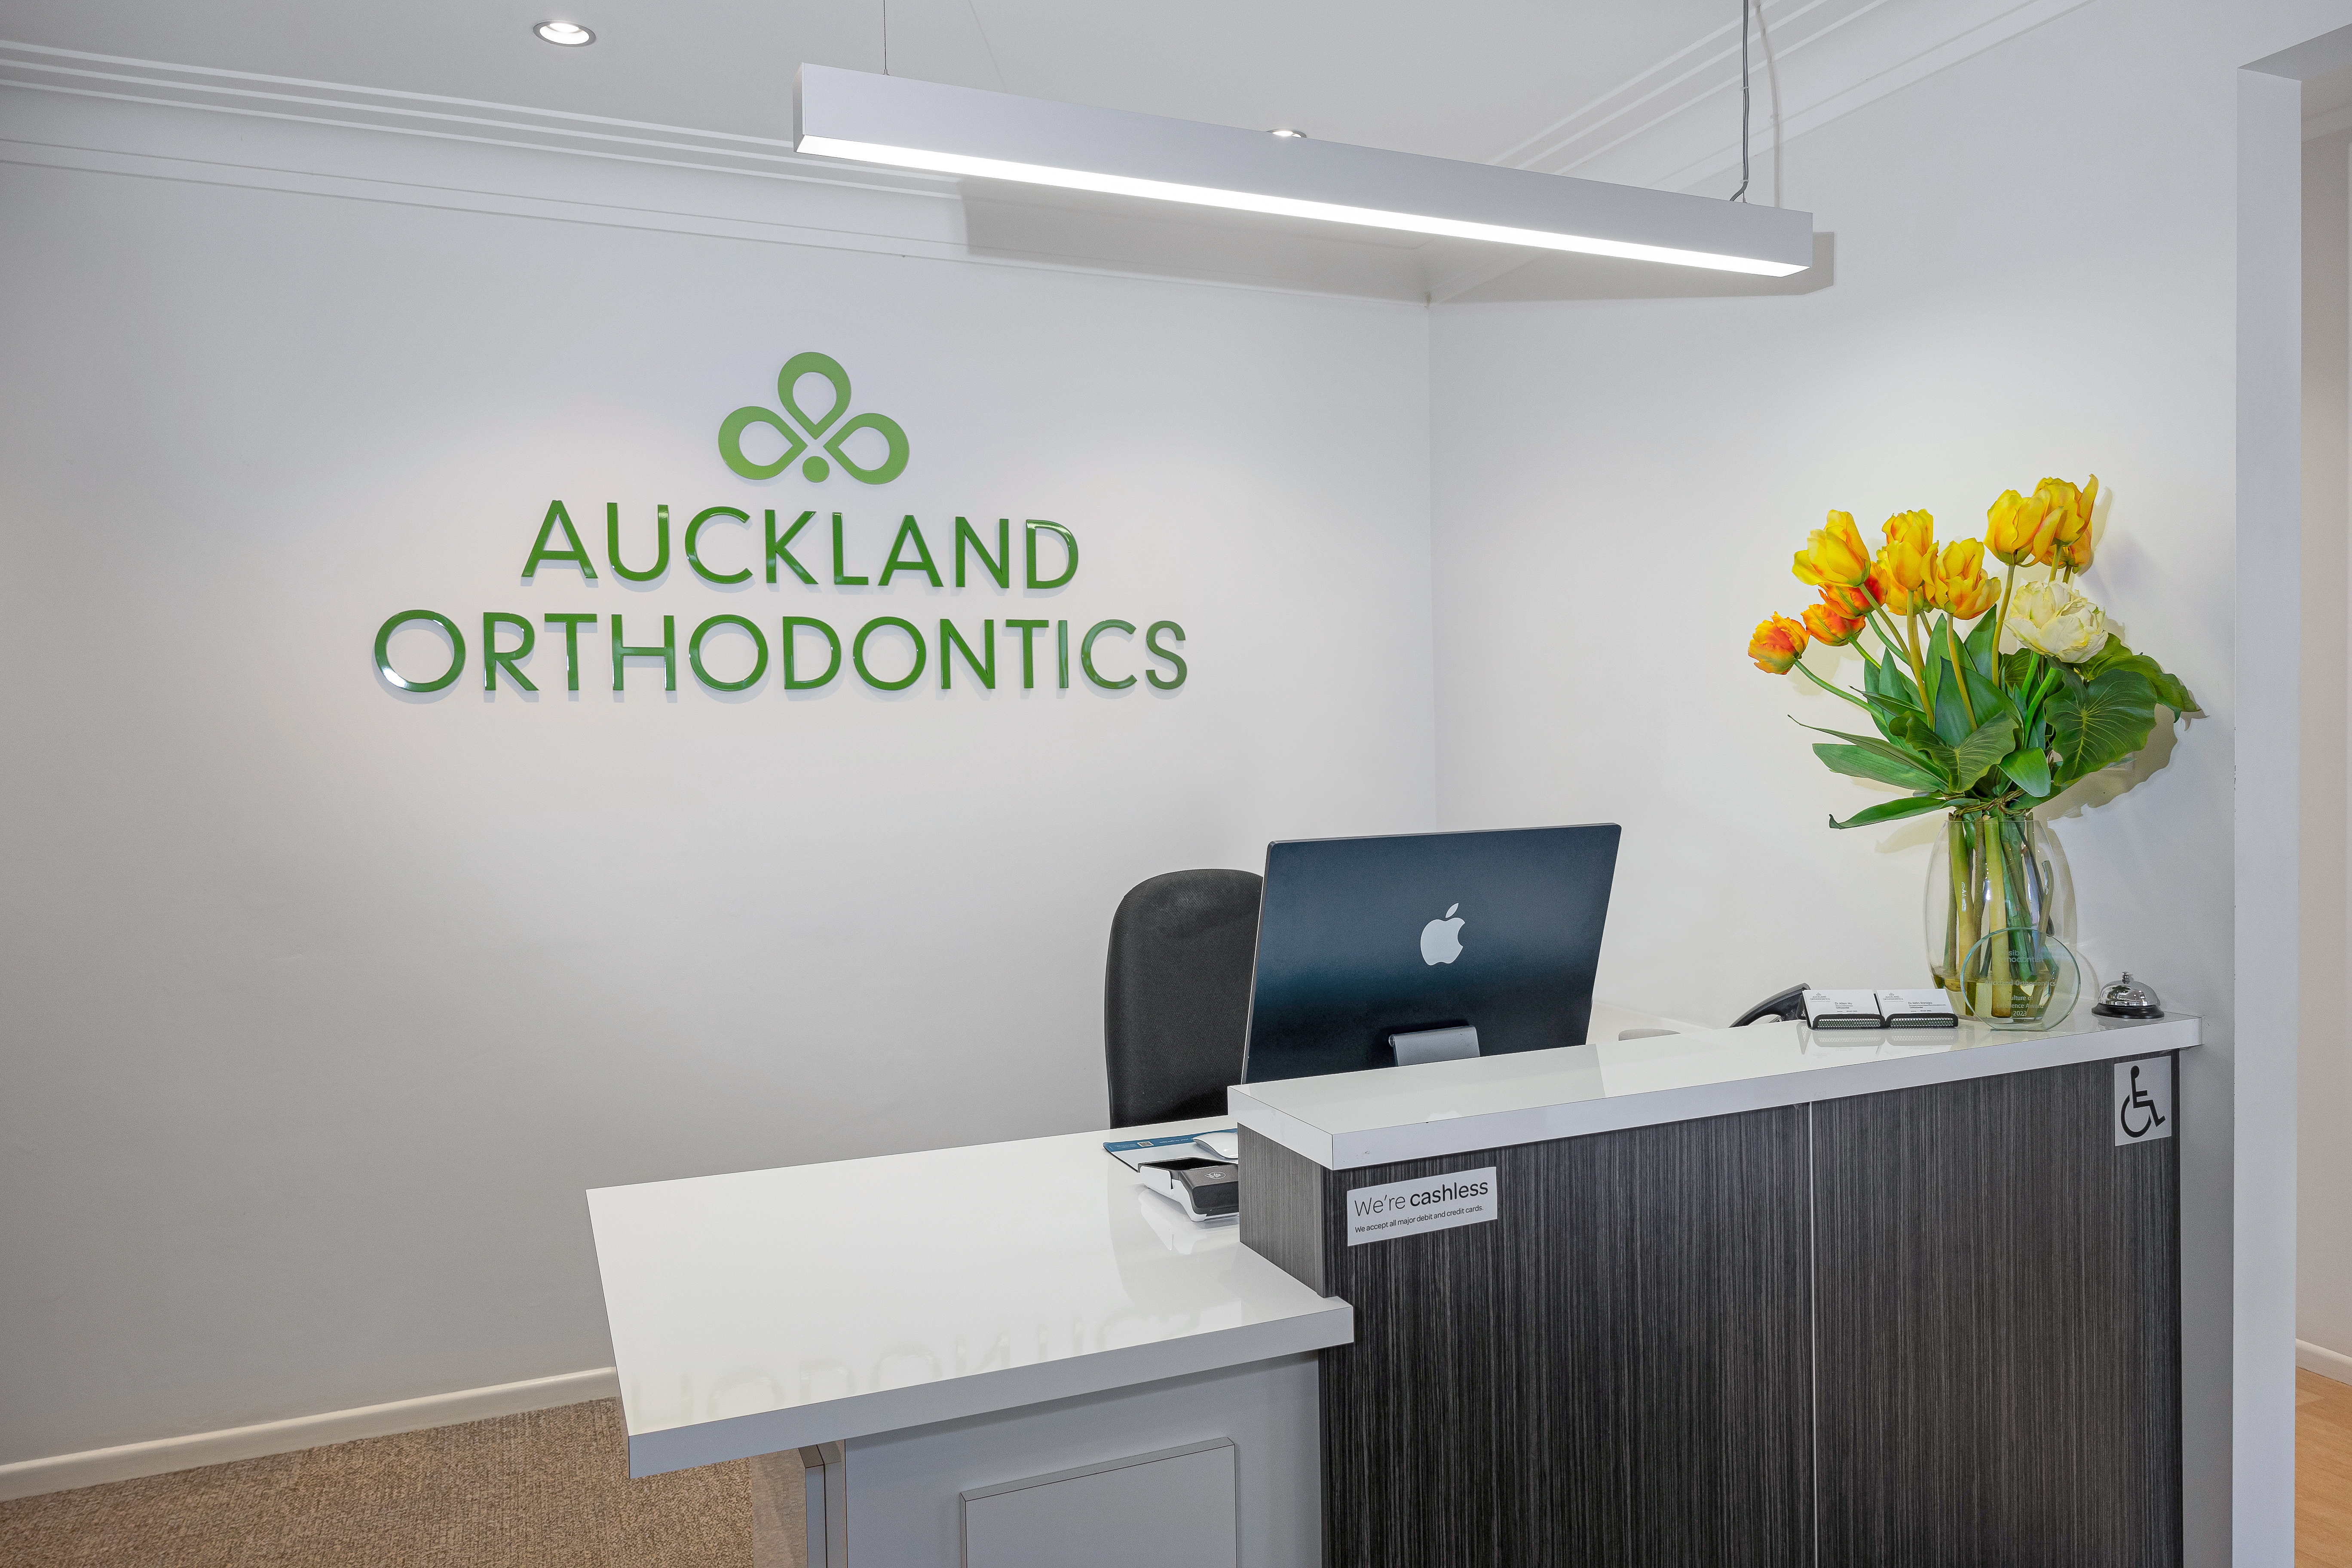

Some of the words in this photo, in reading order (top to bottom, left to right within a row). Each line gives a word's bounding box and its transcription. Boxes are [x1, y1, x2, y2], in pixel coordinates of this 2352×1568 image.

[521, 500, 1079, 589] AUCKLAND
[374, 609, 1187, 693] ORTHODONTICS
[1354, 1194, 1406, 1216] We're
[1410, 1182, 1488, 1207] cashless
[1416, 1213, 1433, 1222] debit
[1433, 1210, 1446, 1219] and
[1446, 1208, 1464, 1216] credit
[1465, 1205, 1484, 1213] cards.
